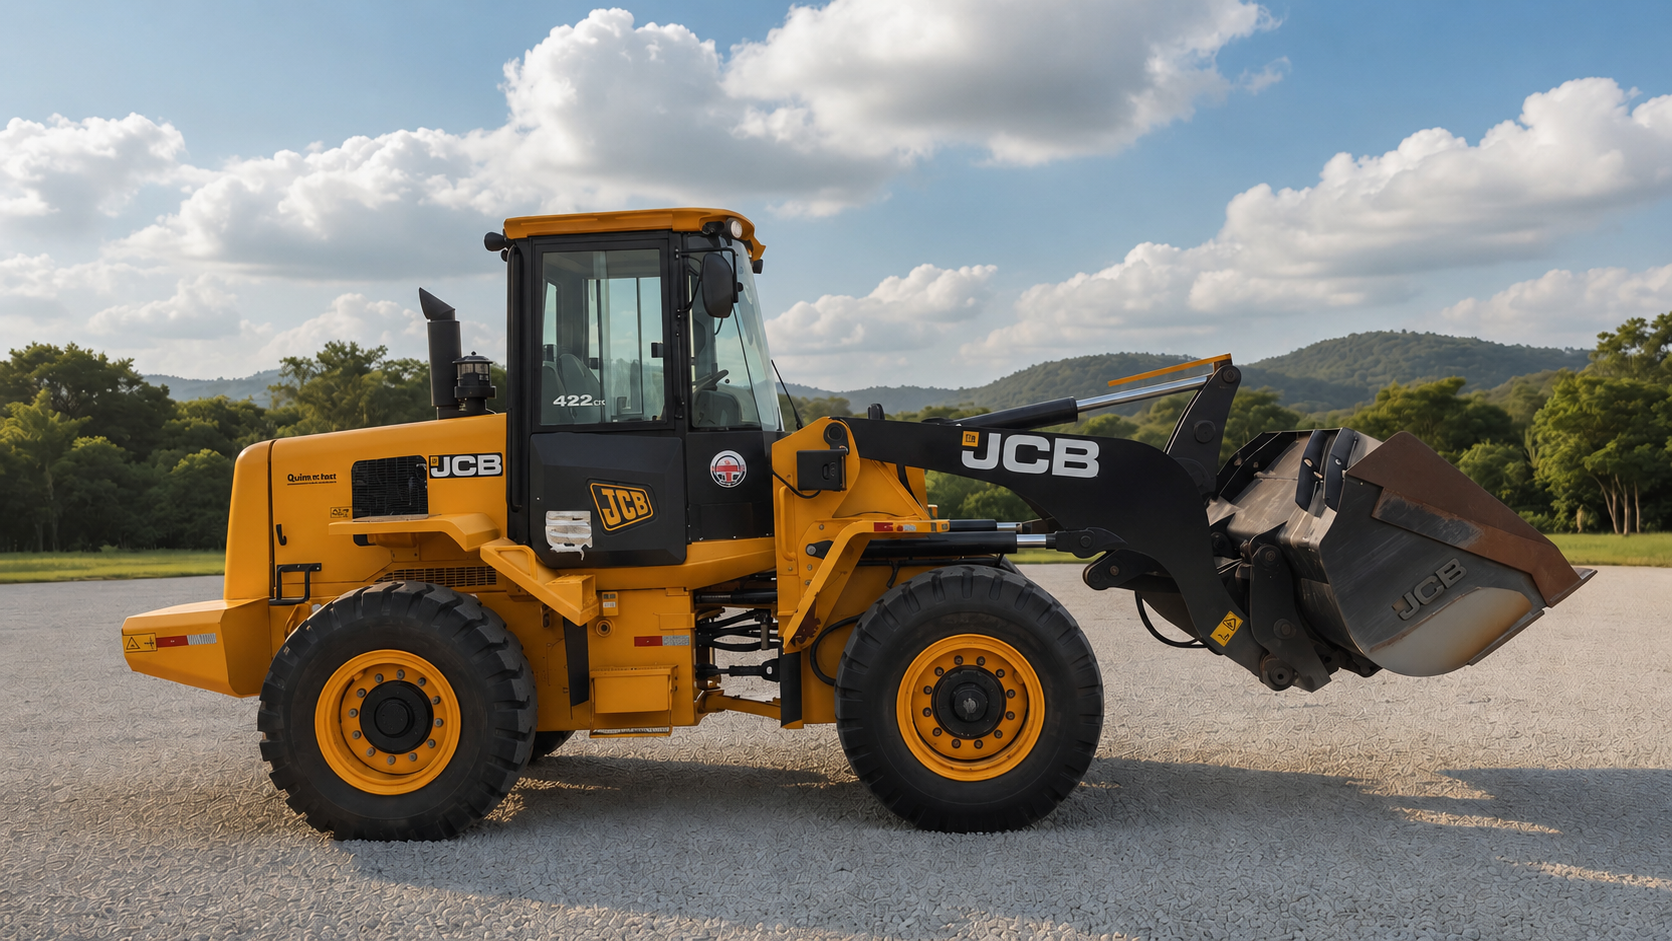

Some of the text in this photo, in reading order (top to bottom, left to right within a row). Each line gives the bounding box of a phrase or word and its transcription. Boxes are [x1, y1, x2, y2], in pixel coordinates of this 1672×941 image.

[430, 454, 502, 478] JCB
[961, 432, 1100, 479] JCB
[601, 488, 649, 526] JCB
[1398, 558, 1467, 621] JCB
